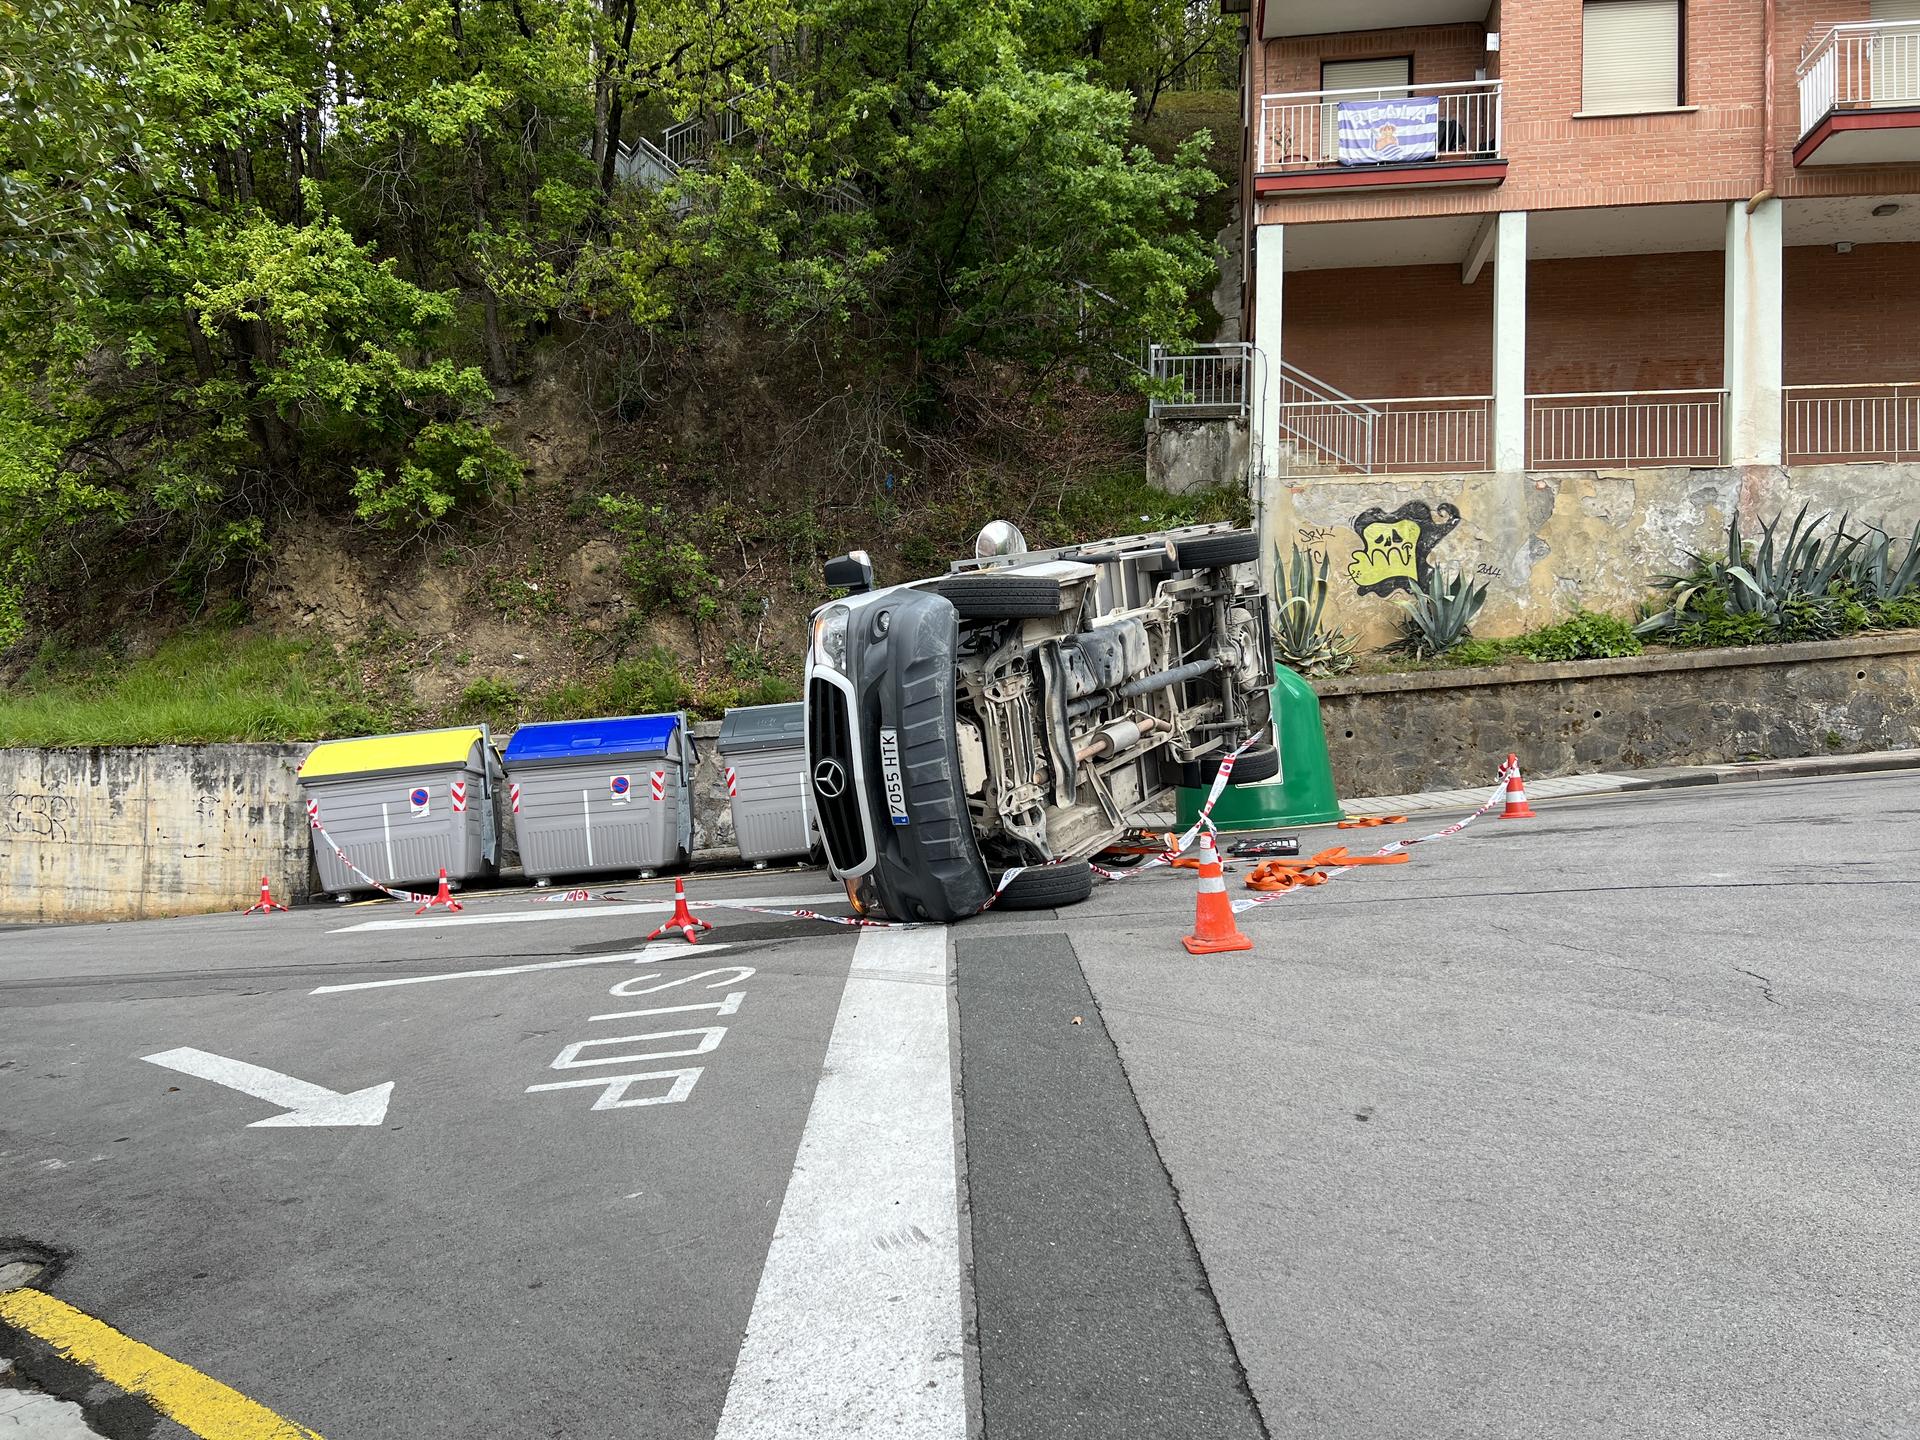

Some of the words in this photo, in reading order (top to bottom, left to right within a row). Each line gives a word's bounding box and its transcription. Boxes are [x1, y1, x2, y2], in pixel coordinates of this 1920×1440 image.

[1350, 104, 1427, 129] REALA
[882, 736, 897, 766] HTK
[886, 772, 904, 813] 7055
[524, 966, 756, 1111] STOP
